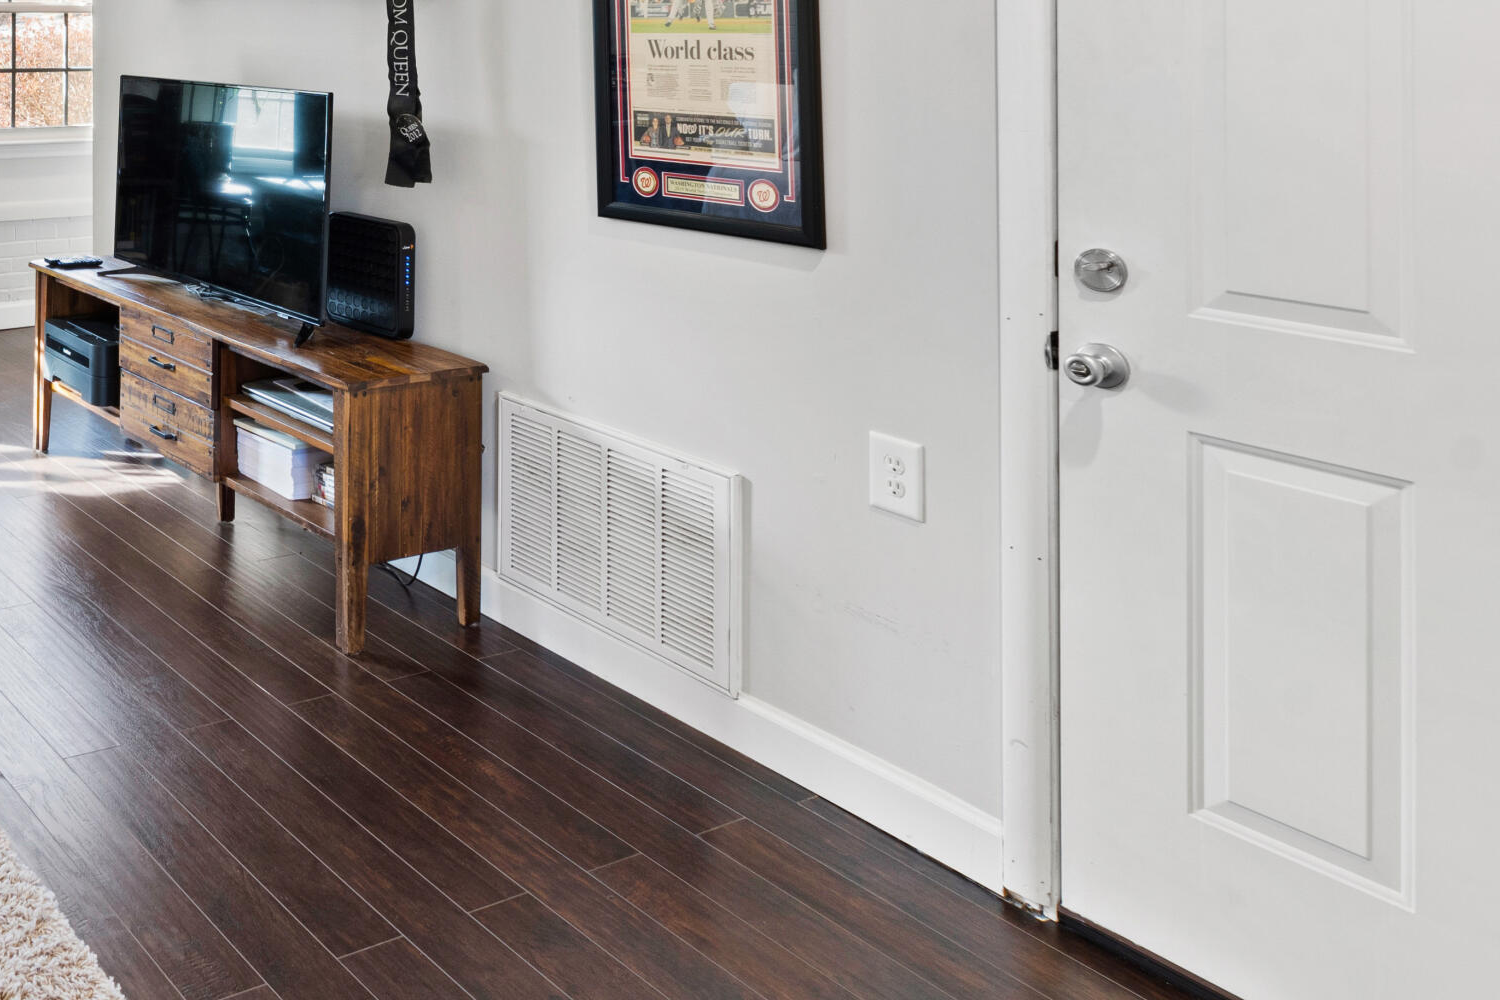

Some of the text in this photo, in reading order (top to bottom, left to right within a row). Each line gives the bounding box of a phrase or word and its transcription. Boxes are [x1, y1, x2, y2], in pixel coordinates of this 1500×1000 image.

[647, 39, 755, 61] World class
[390, 29, 409, 97] QUEEN
[405, 128, 422, 142] 2012
[698, 124, 714, 136] IT'S
[714, 126, 745, 138] OUR
